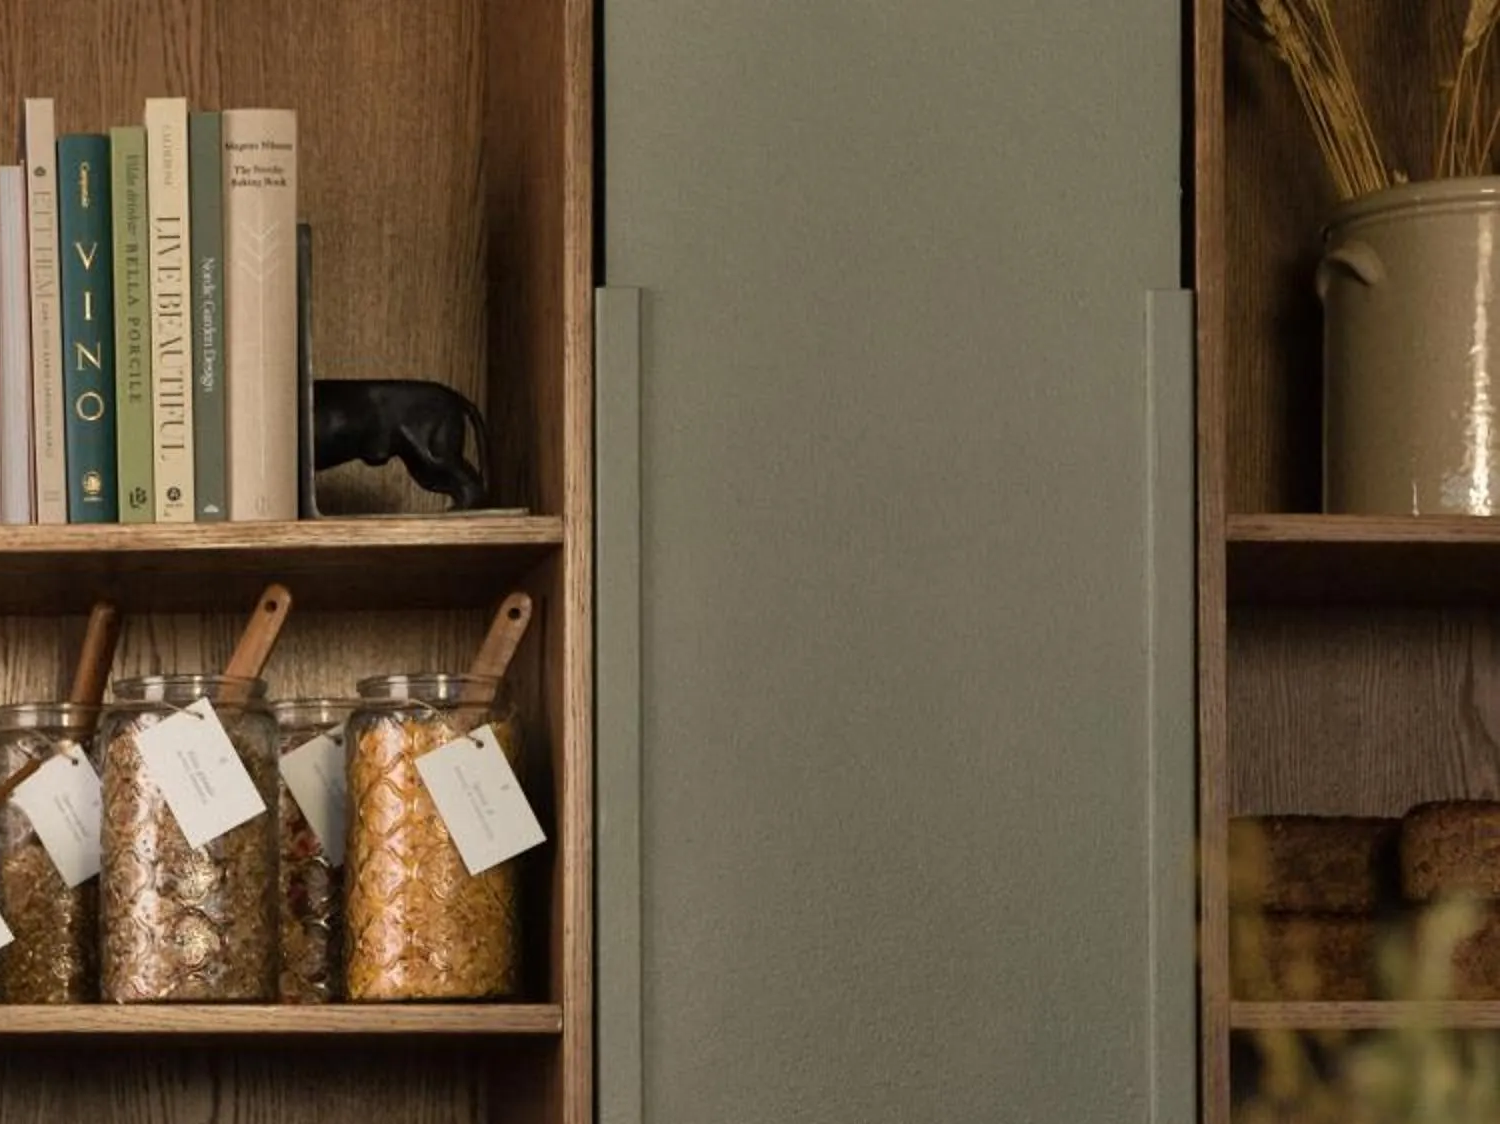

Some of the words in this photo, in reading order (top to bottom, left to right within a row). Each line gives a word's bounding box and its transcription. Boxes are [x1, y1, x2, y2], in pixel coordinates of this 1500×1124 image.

[75, 241, 104, 421] VINO
[156, 216, 183, 284] LIVE
[157, 291, 185, 462] BEAUTIFUL
